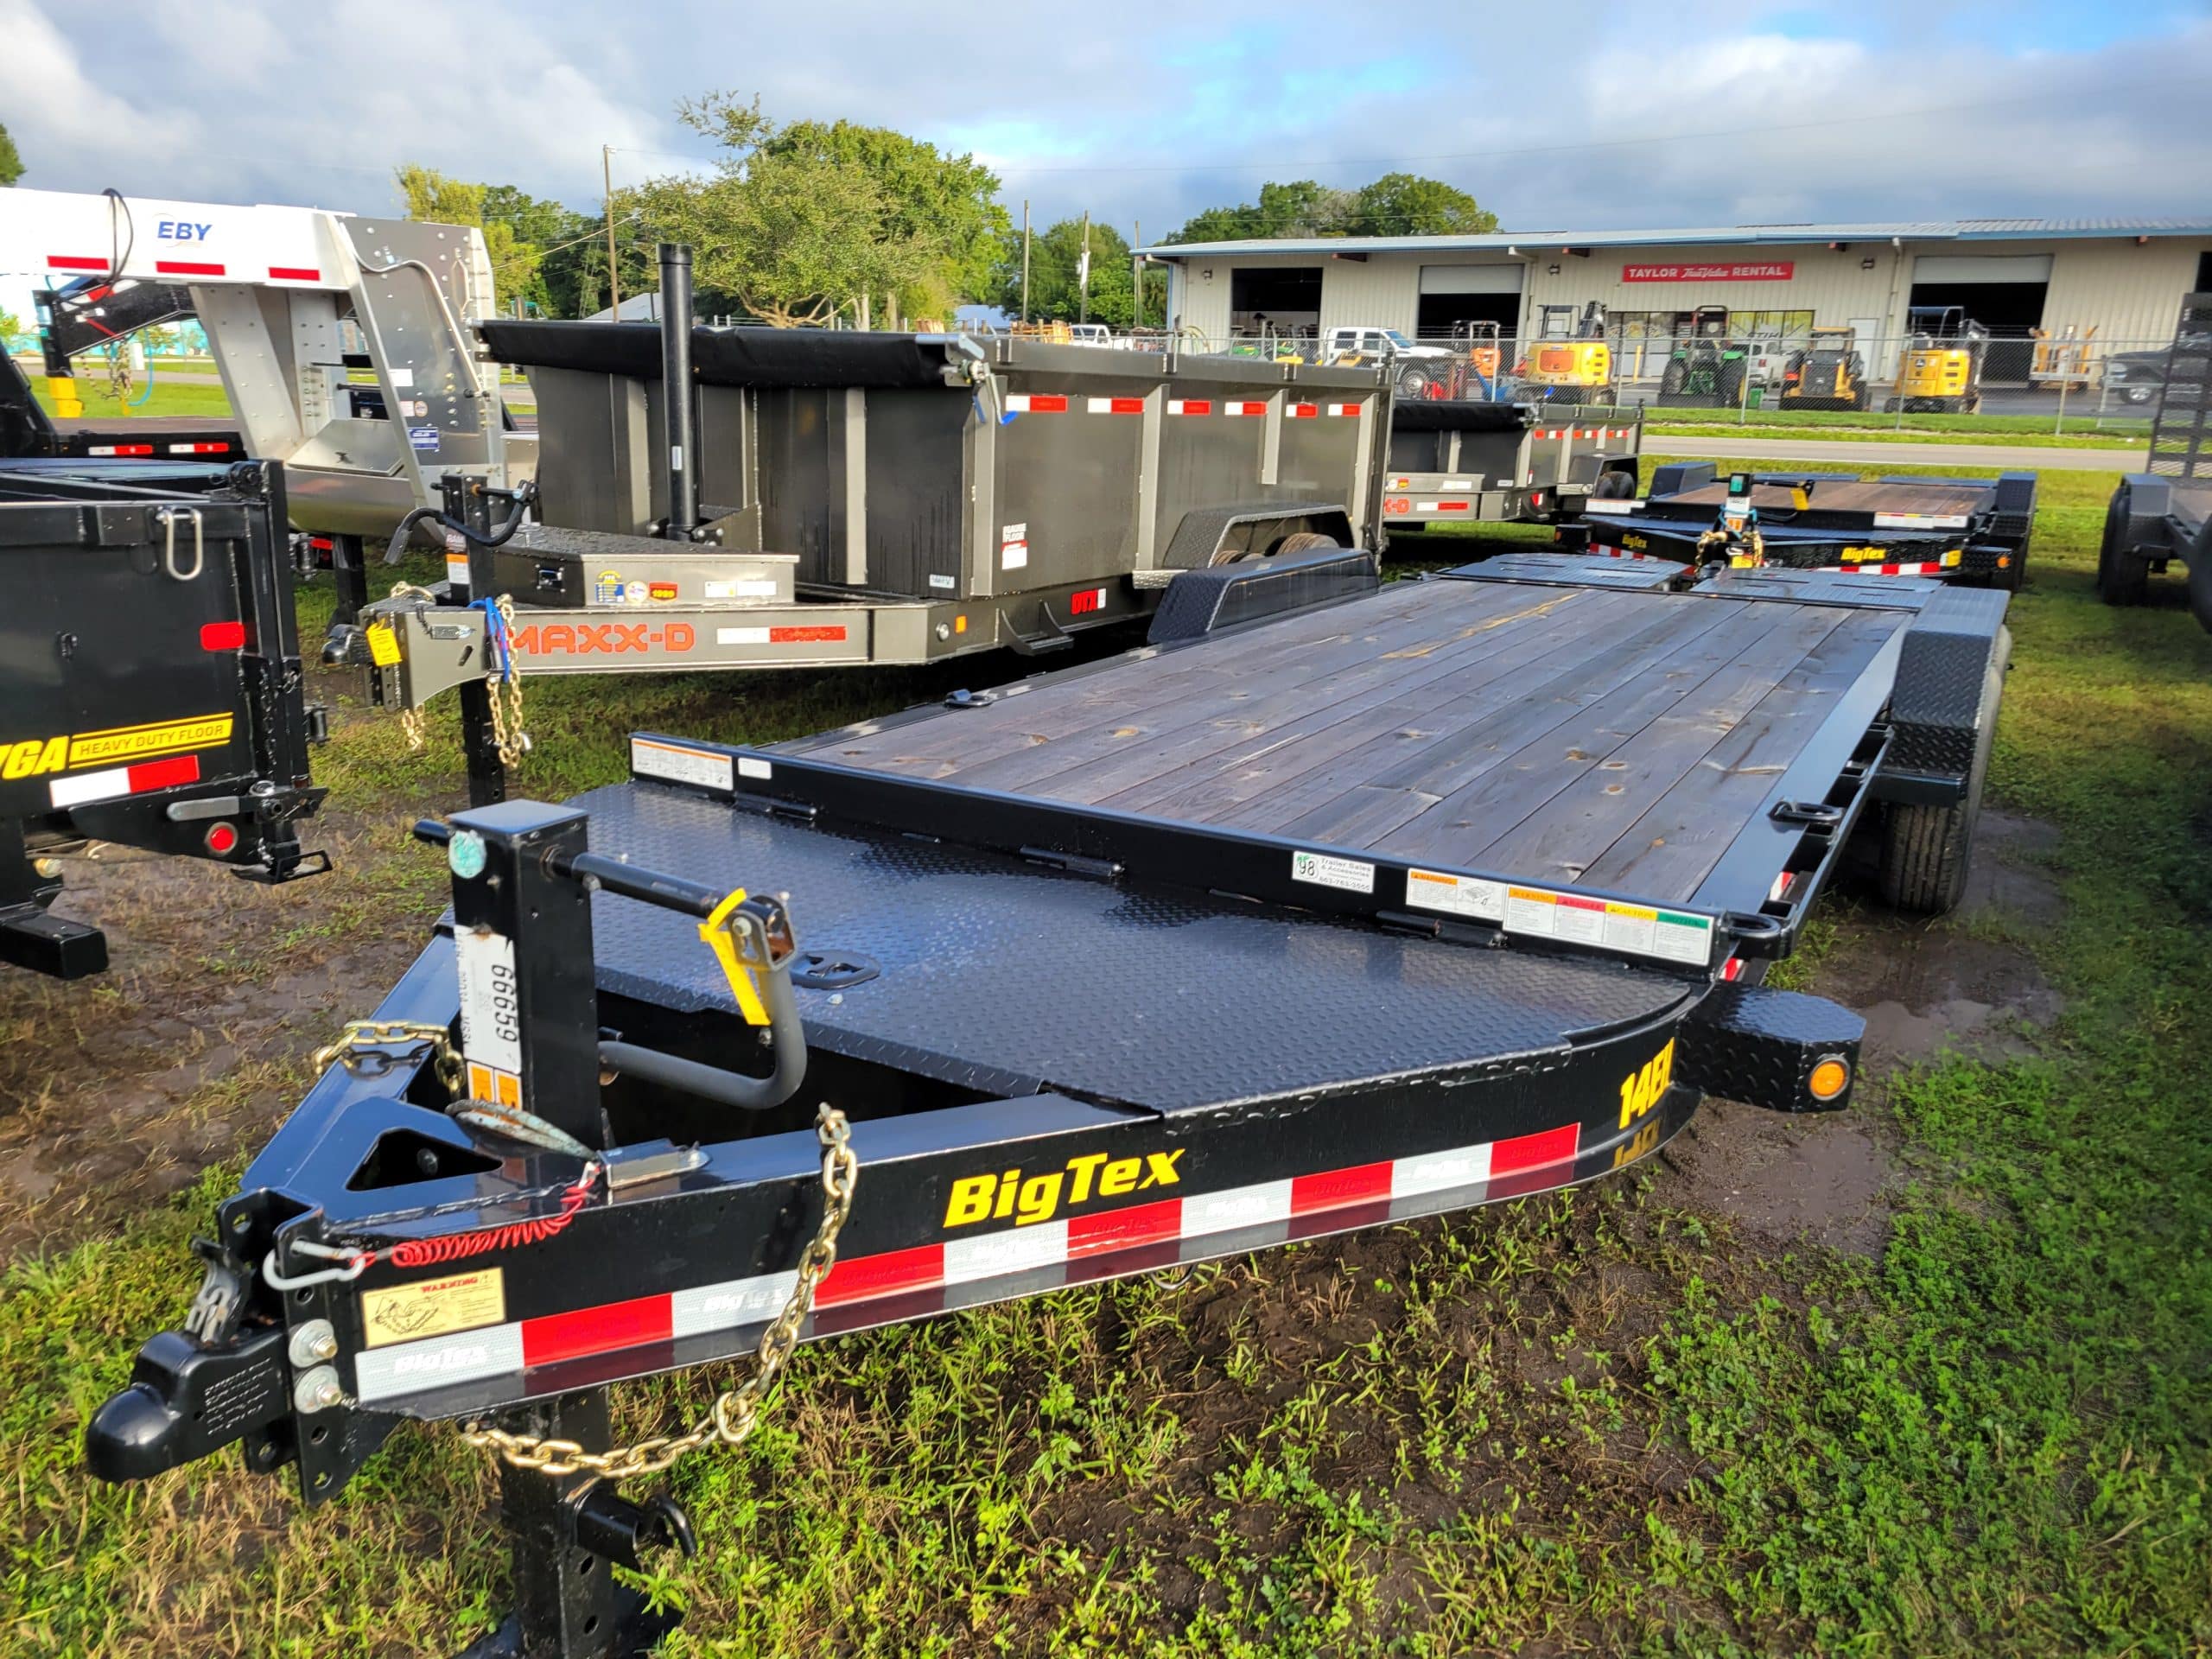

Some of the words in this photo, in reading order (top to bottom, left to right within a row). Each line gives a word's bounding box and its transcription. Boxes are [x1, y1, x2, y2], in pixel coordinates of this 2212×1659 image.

[157, 221, 213, 241] EBY
[1629, 268, 1677, 278] TAYLOR
[1732, 266, 1784, 276] RENTAL
[1840, 547, 1887, 563] BigTex
[507, 623, 695, 654] MAXX-D
[79, 739, 132, 756] HEAVY
[135, 732, 175, 747] DUTY
[179, 724, 225, 741] FLOOR
[491, 963, 518, 1043] 66659
[943, 1147, 1186, 1228] BigTex
[420, 1276, 479, 1294] WARNING
